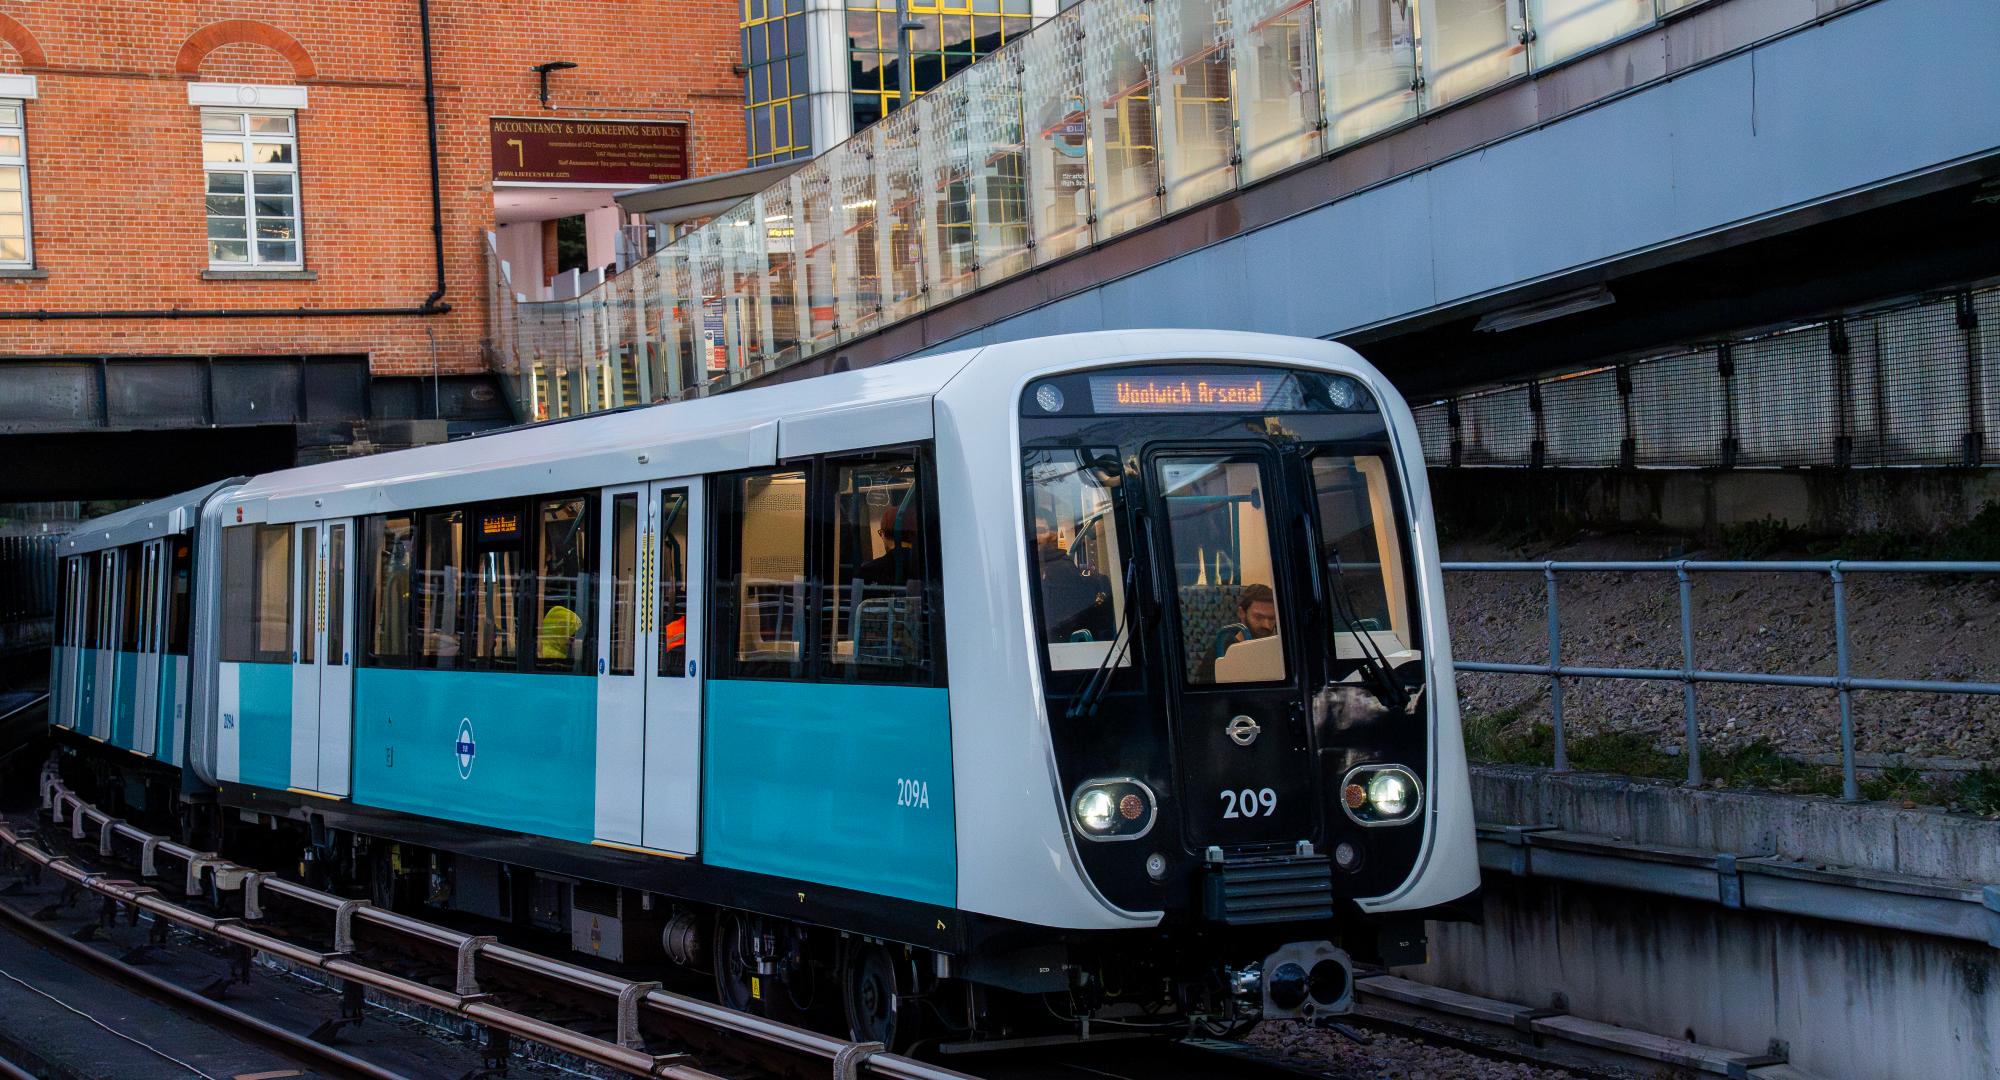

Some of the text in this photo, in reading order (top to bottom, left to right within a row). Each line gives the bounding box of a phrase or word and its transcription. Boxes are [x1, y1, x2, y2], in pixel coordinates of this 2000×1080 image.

[494, 122, 680, 137] ACCOUNTANCY & BOOKKEEPING SERVICES
[1117, 380, 1262, 404] Woolwich Arsenal
[897, 778, 930, 809] 209A
[1220, 787, 1277, 819] 209
